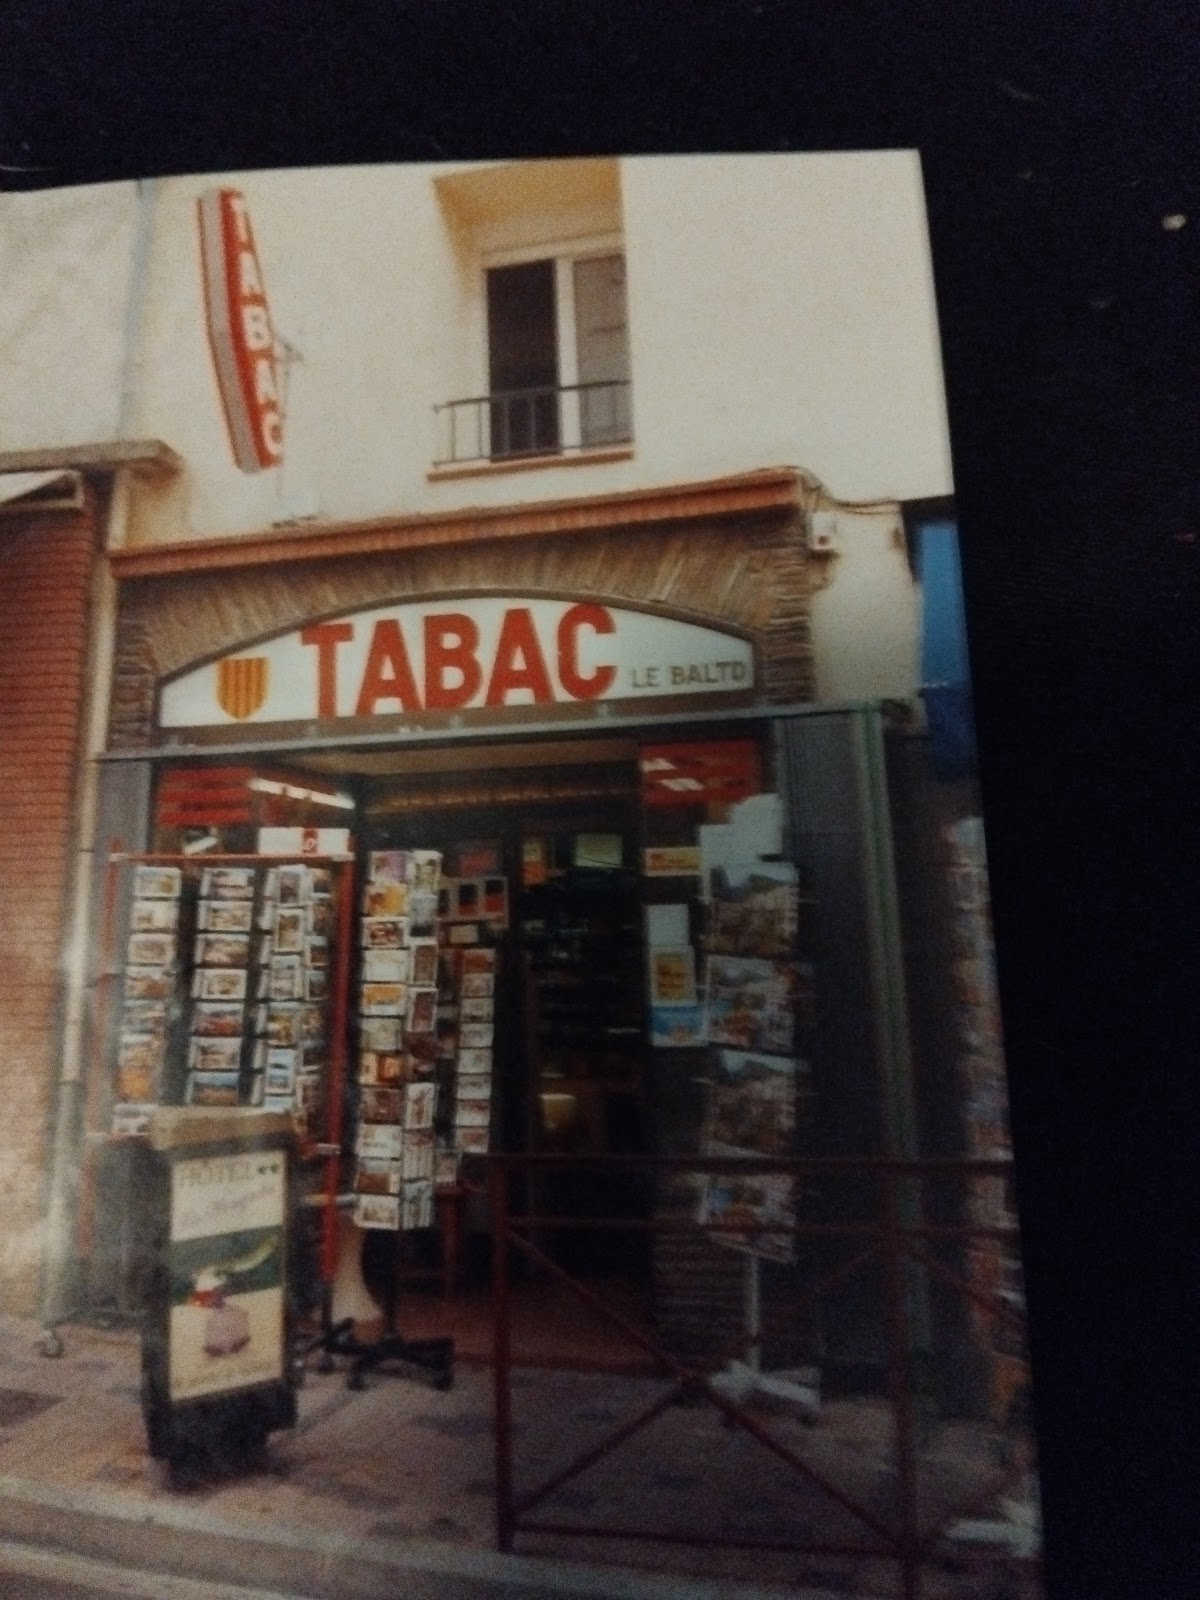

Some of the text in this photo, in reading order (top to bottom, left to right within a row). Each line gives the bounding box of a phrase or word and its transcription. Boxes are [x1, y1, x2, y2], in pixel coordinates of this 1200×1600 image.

[229, 194, 283, 456] TABAC
[302, 602, 617, 719] TABAC
[630, 660, 747, 688] LE BALTO
